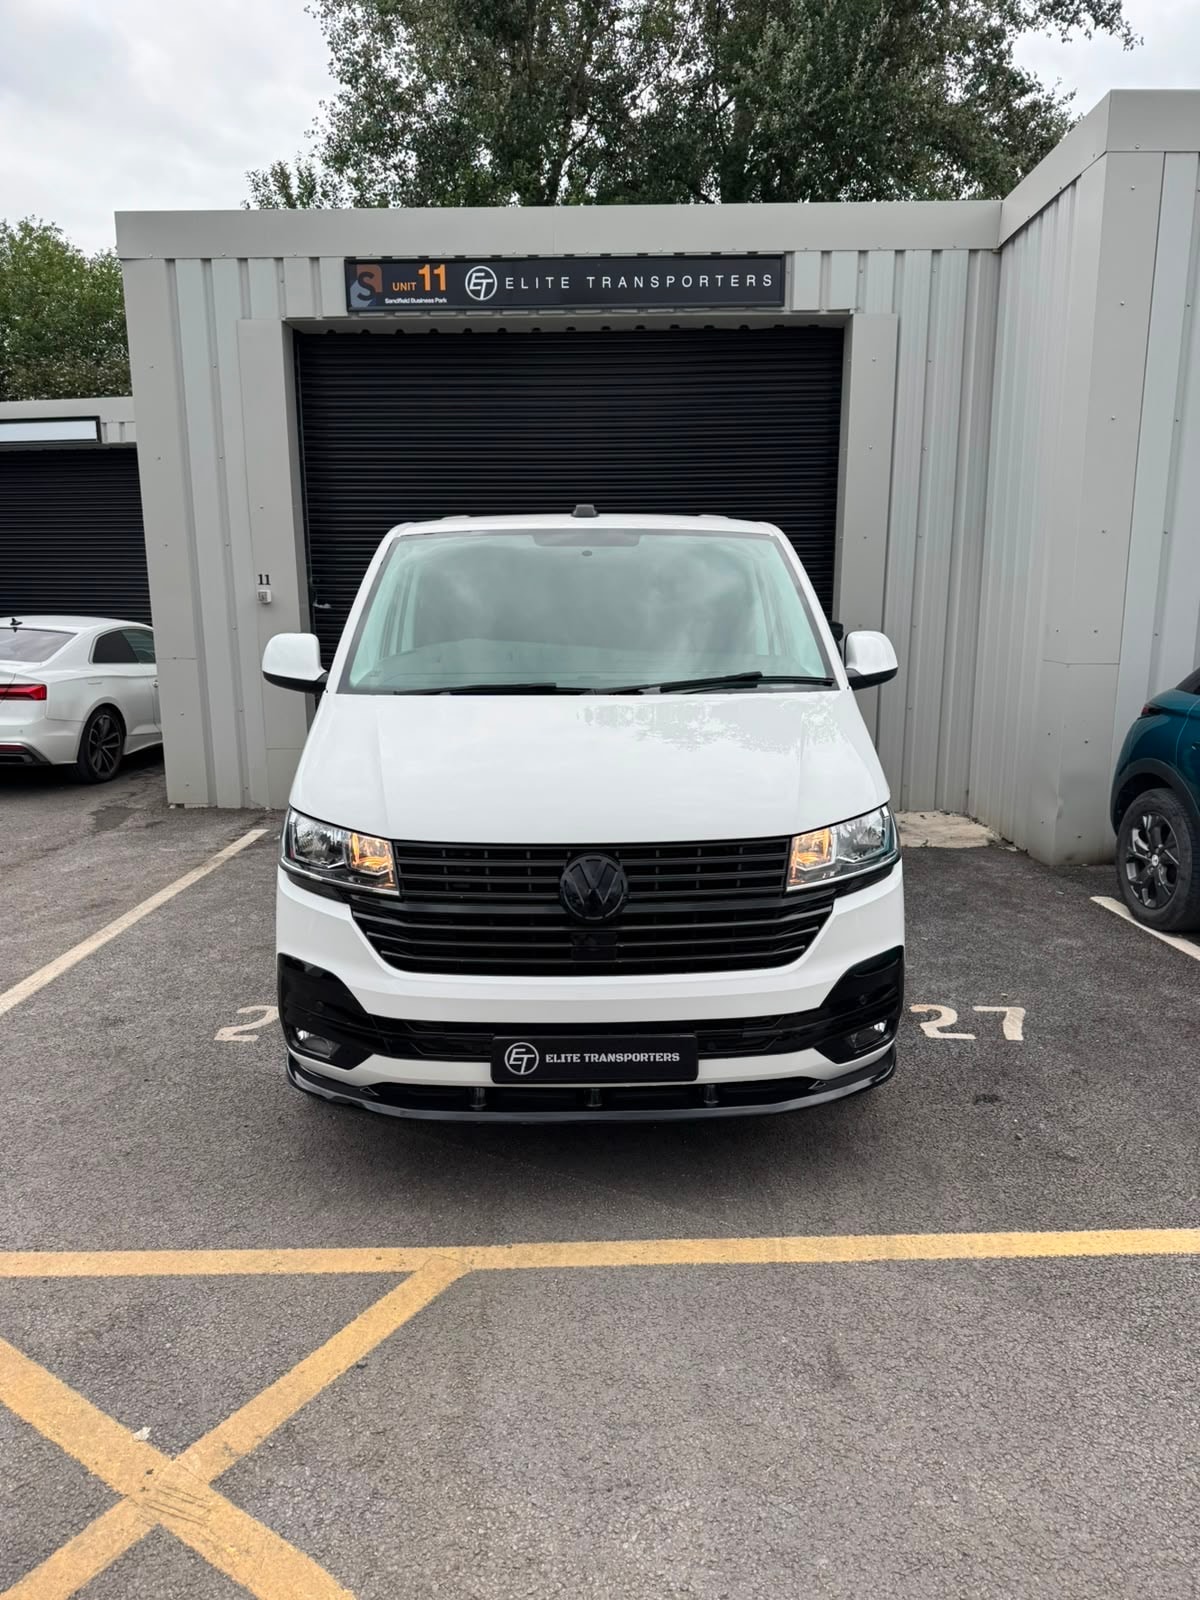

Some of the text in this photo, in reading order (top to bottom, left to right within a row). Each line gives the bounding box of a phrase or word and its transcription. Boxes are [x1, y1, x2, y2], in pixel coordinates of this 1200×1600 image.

[392, 264, 447, 292] UNIT 11
[505, 276, 570, 289] ELITE
[586, 274, 773, 289] TRANSPORTERS
[257, 573, 271, 586] 11
[561, 854, 627, 919] VW
[909, 1003, 1026, 1041] 27
[545, 1053, 581, 1063] ELITE
[584, 1052, 680, 1063] TRANSPORTERS
